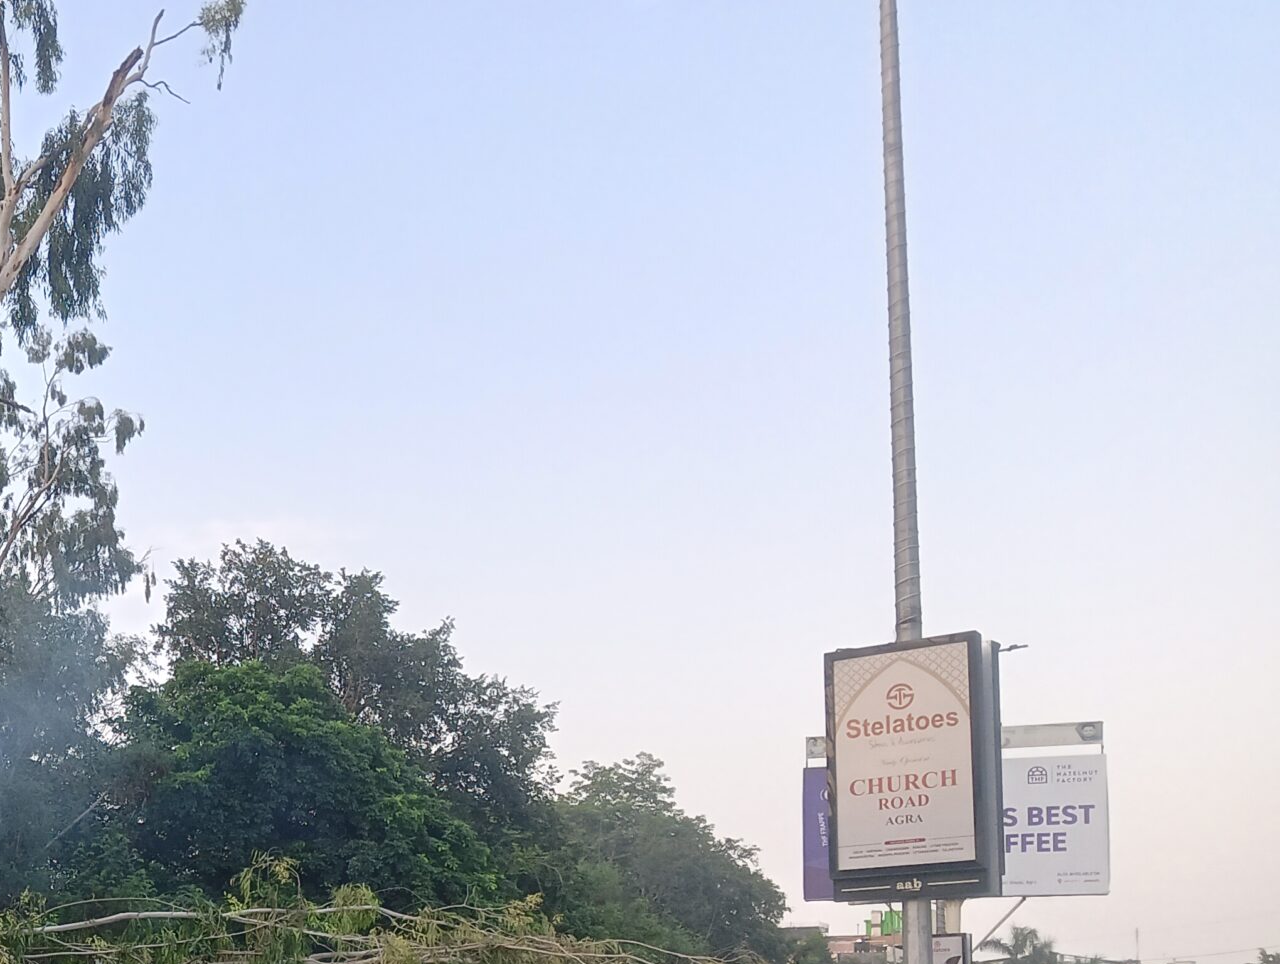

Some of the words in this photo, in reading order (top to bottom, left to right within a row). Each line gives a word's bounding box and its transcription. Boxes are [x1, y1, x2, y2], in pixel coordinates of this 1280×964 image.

[846, 711, 959, 739] Stelatoes
[849, 769, 958, 797] CHURCH
[878, 793, 930, 811] ROAD
[884, 814, 924, 826] AGRA
[1003, 807, 1018, 827] S
[1027, 804, 1096, 826] BEST
[1005, 832, 1067, 853] FFEE
[895, 878, 922, 890] aab
